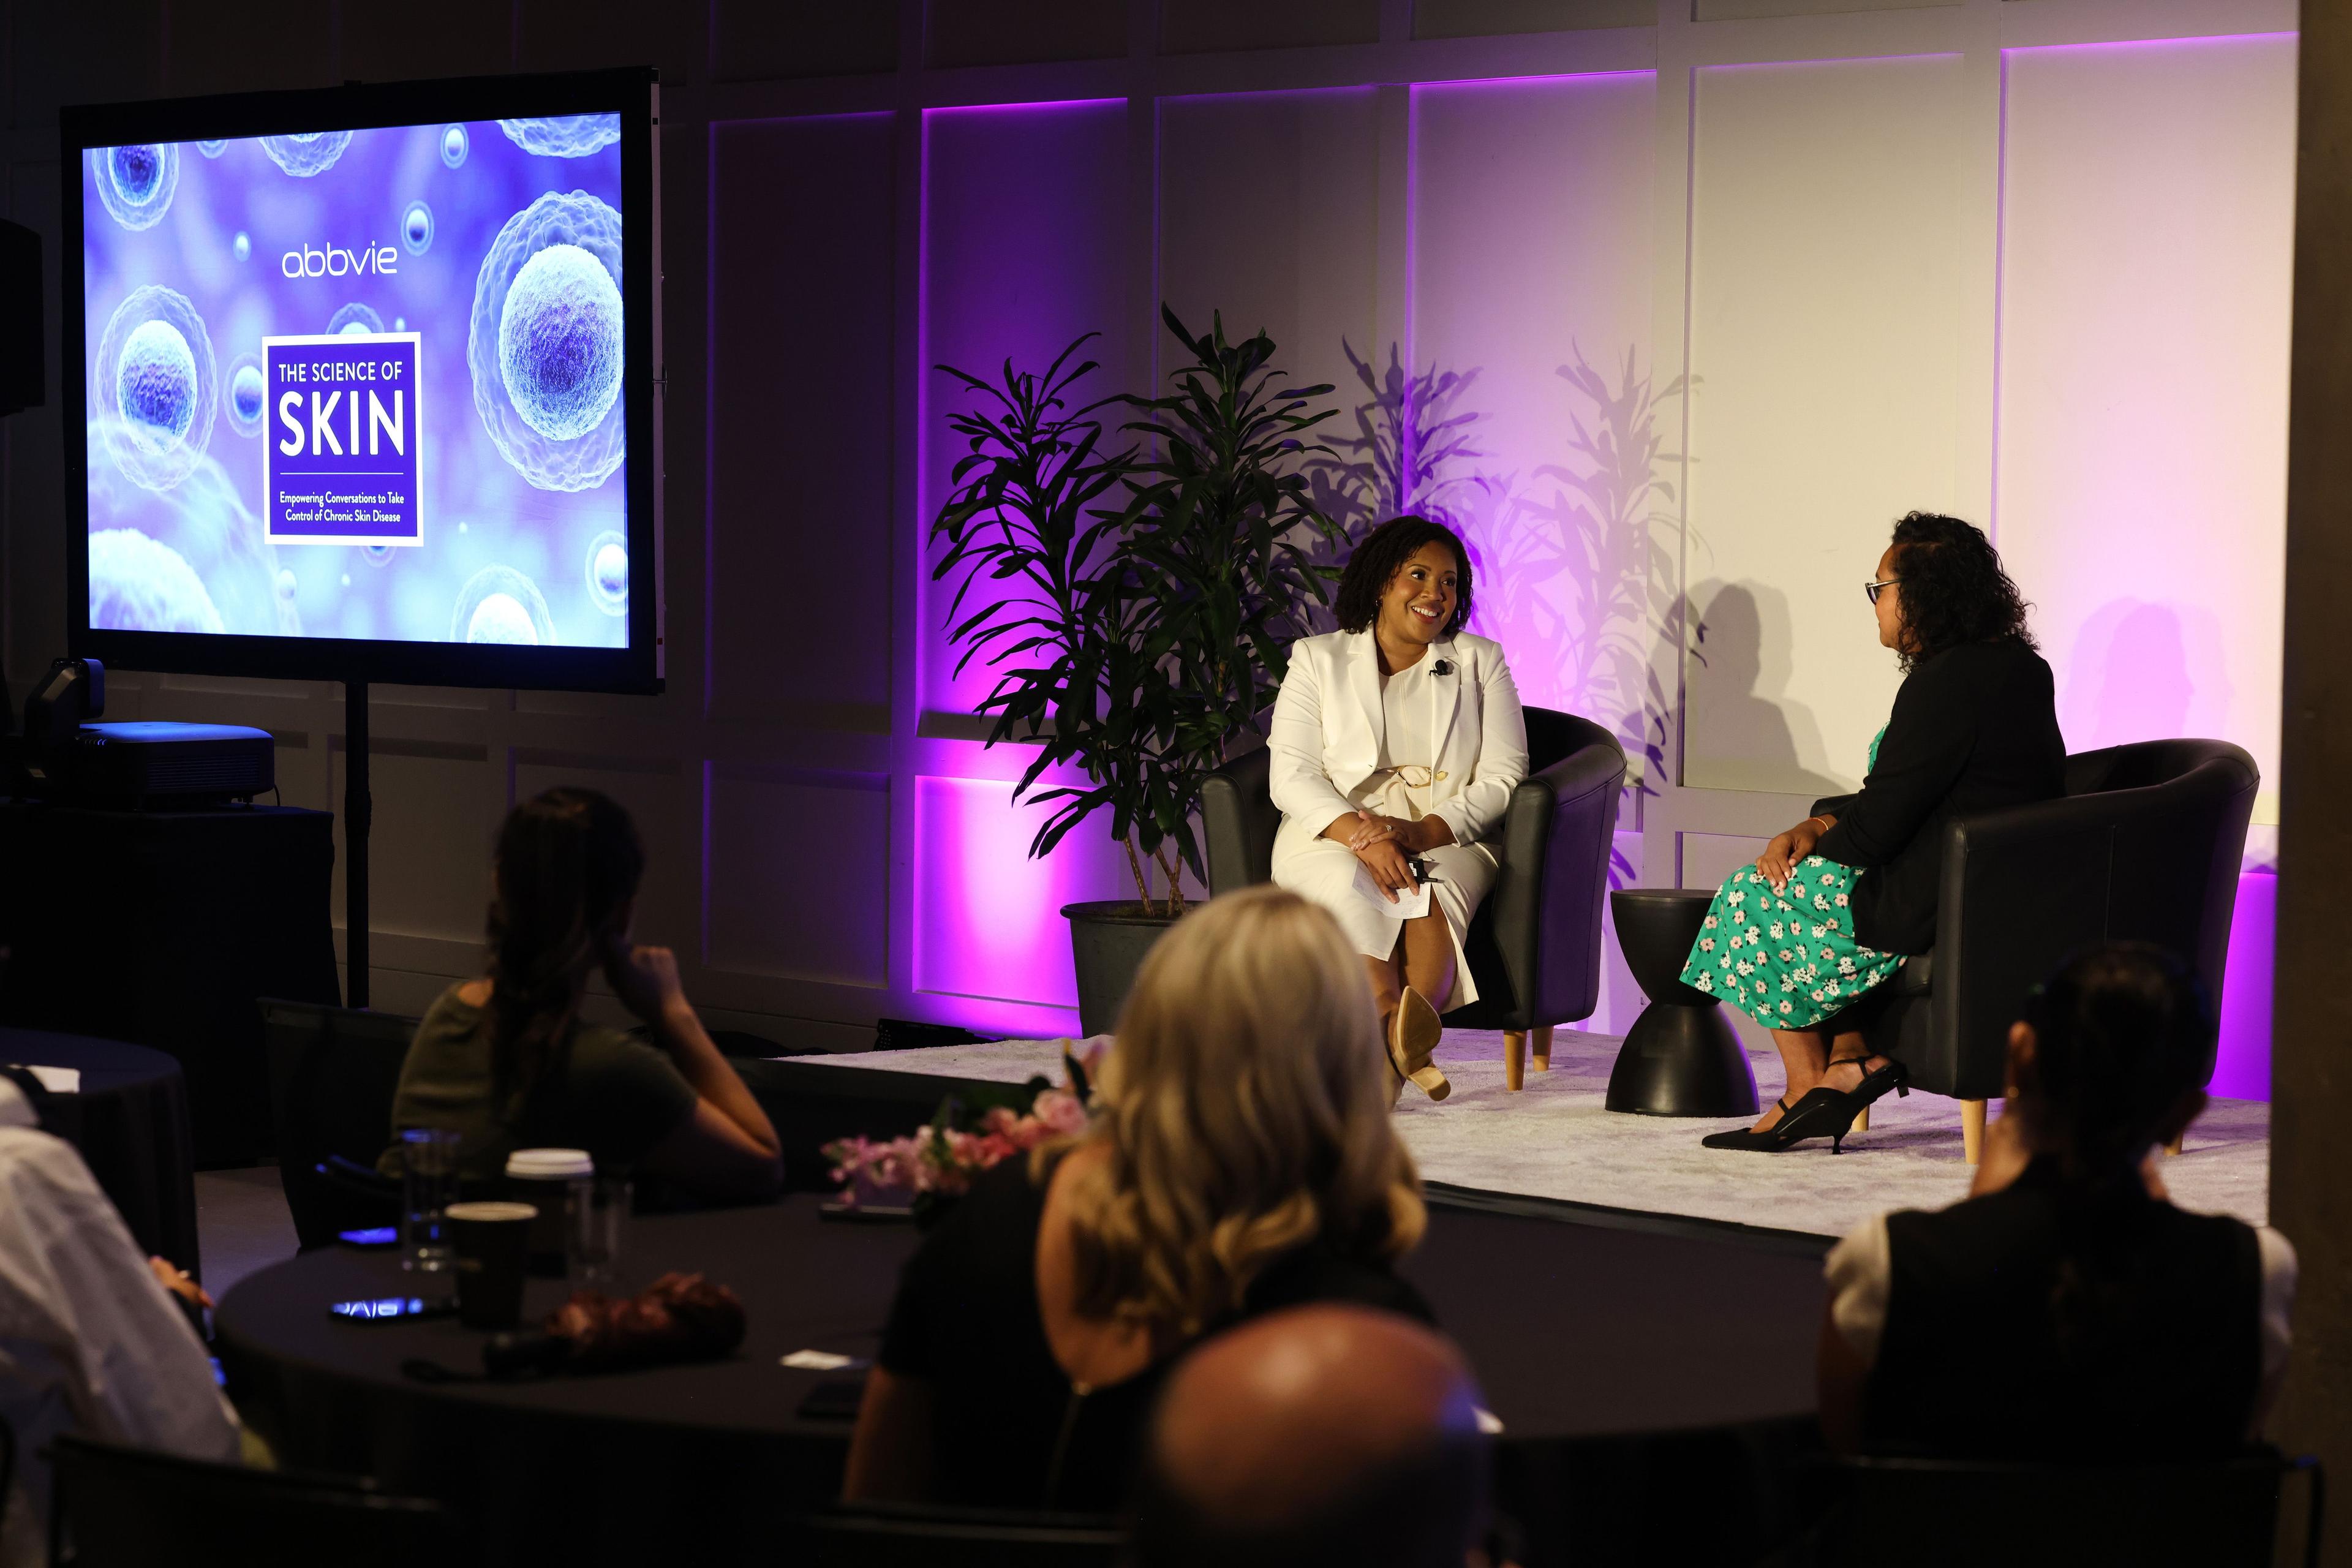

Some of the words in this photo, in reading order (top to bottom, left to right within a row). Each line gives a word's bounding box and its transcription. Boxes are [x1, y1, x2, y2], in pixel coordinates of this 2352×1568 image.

[282, 241, 398, 279] abbvie
[279, 363, 307, 382] THE
[312, 362, 375, 382] SCIENCE
[381, 361, 402, 380] OF
[279, 390, 404, 456] SKIN
[279, 491, 324, 507] Empowering
[325, 491, 376, 503] Conversations
[378, 494, 386, 503] to
[387, 492, 404, 503] Take
[285, 509, 313, 521] Control
[314, 510, 323, 521] of
[323, 509, 353, 521] Chronic
[355, 510, 371, 522] Skin
[373, 510, 401, 522] Disease
